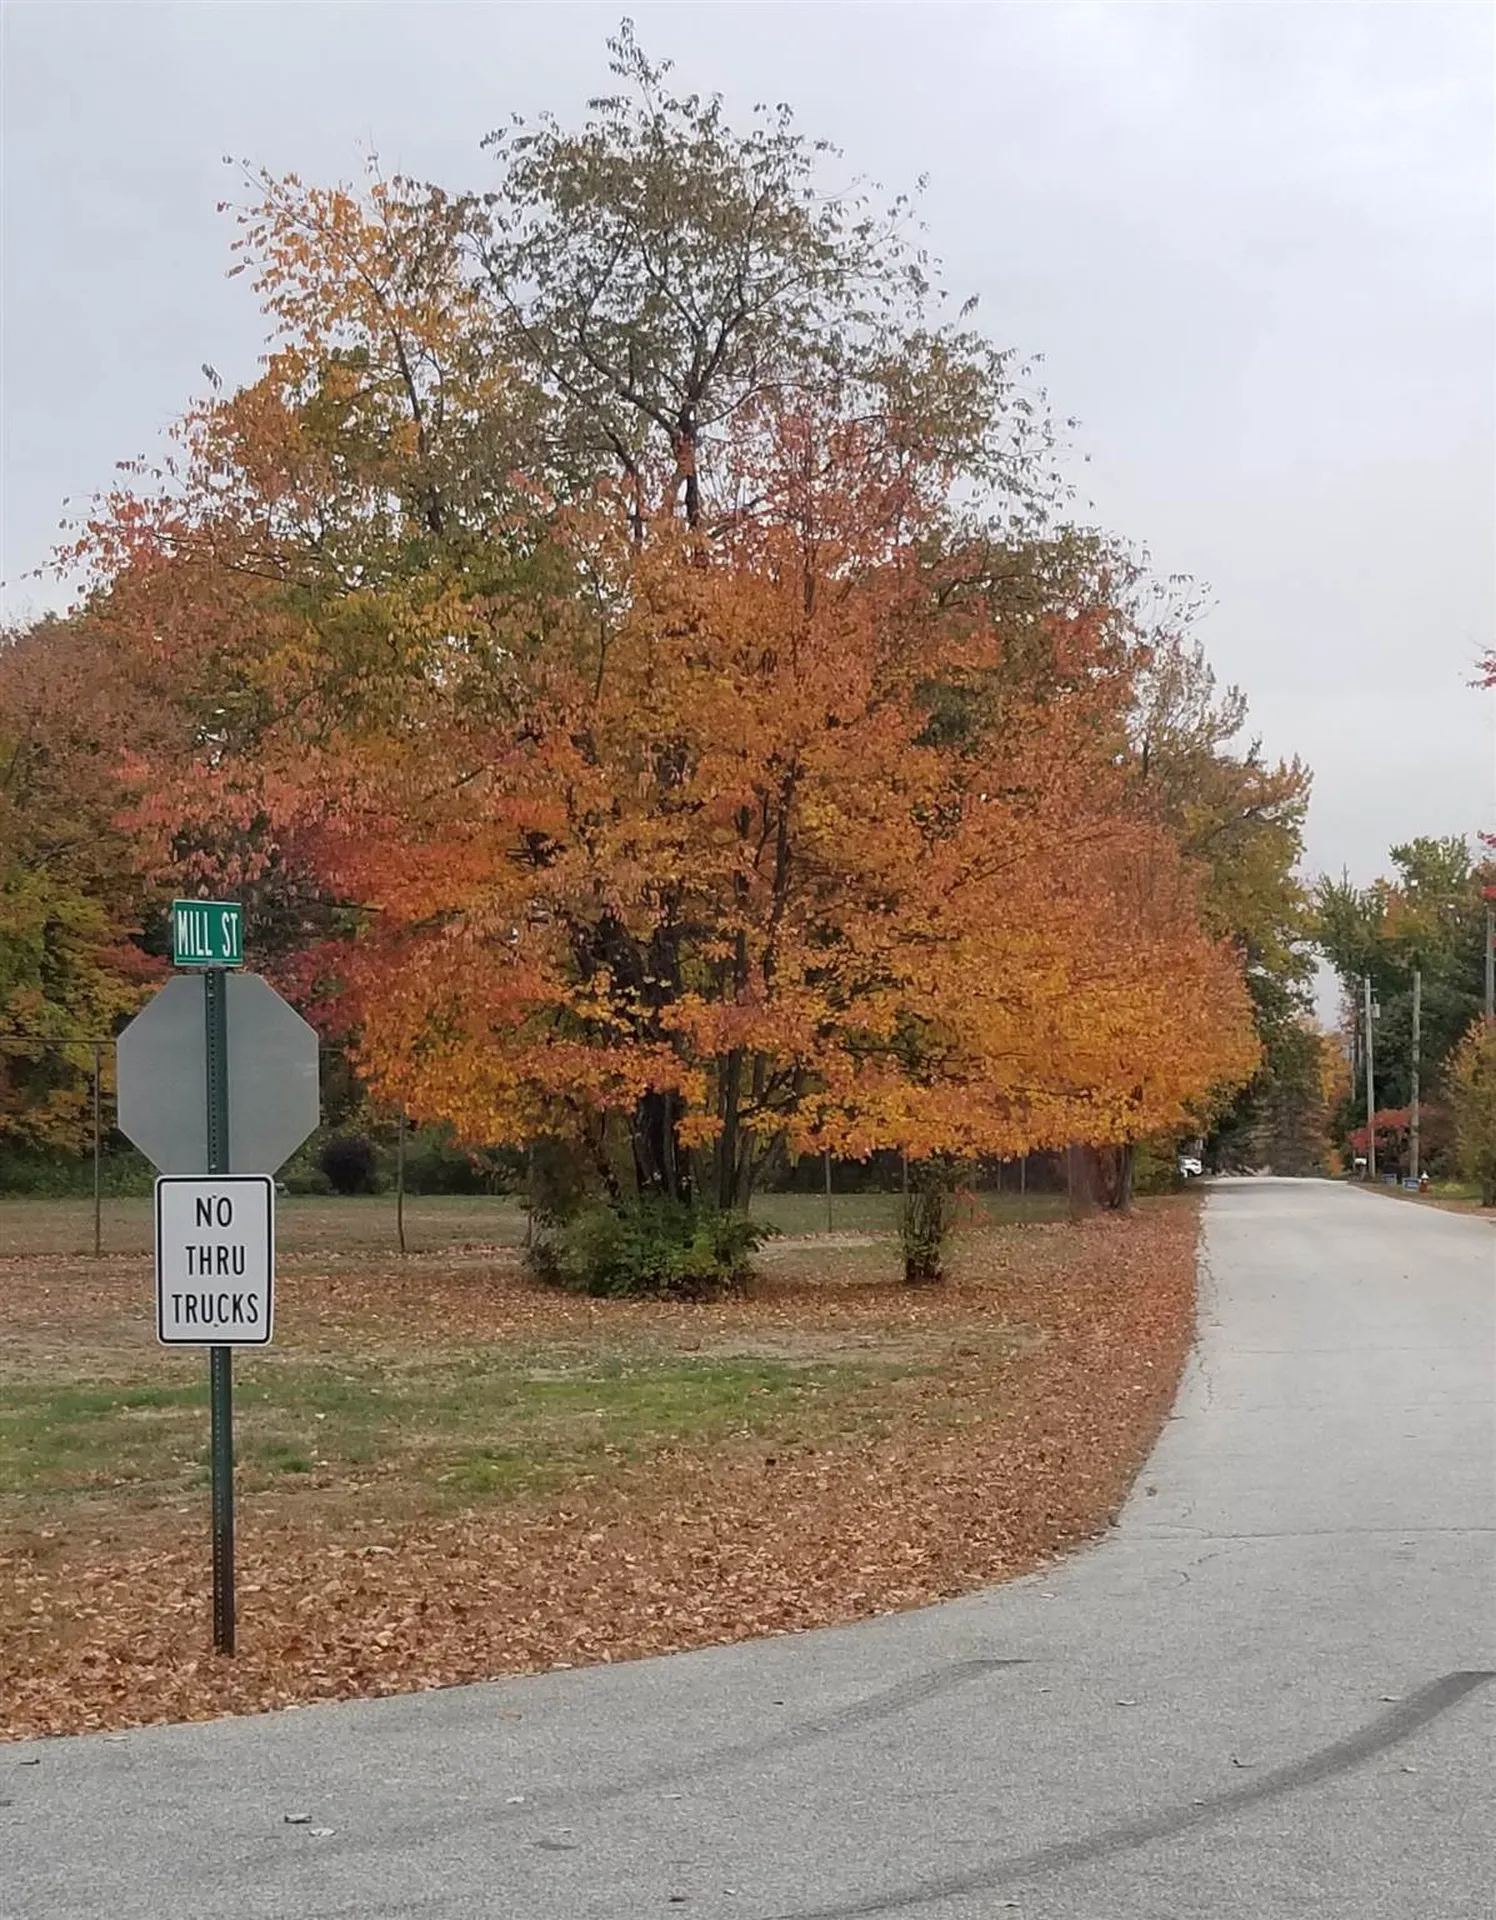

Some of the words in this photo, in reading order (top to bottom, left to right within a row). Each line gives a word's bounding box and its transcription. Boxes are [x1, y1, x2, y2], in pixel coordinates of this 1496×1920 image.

[178, 910, 213, 956] MILL
[222, 911, 238, 957] ST
[196, 1197, 232, 1227] NO
[185, 1245, 245, 1275] THRU
[171, 1293, 258, 1324] TRUCKS
